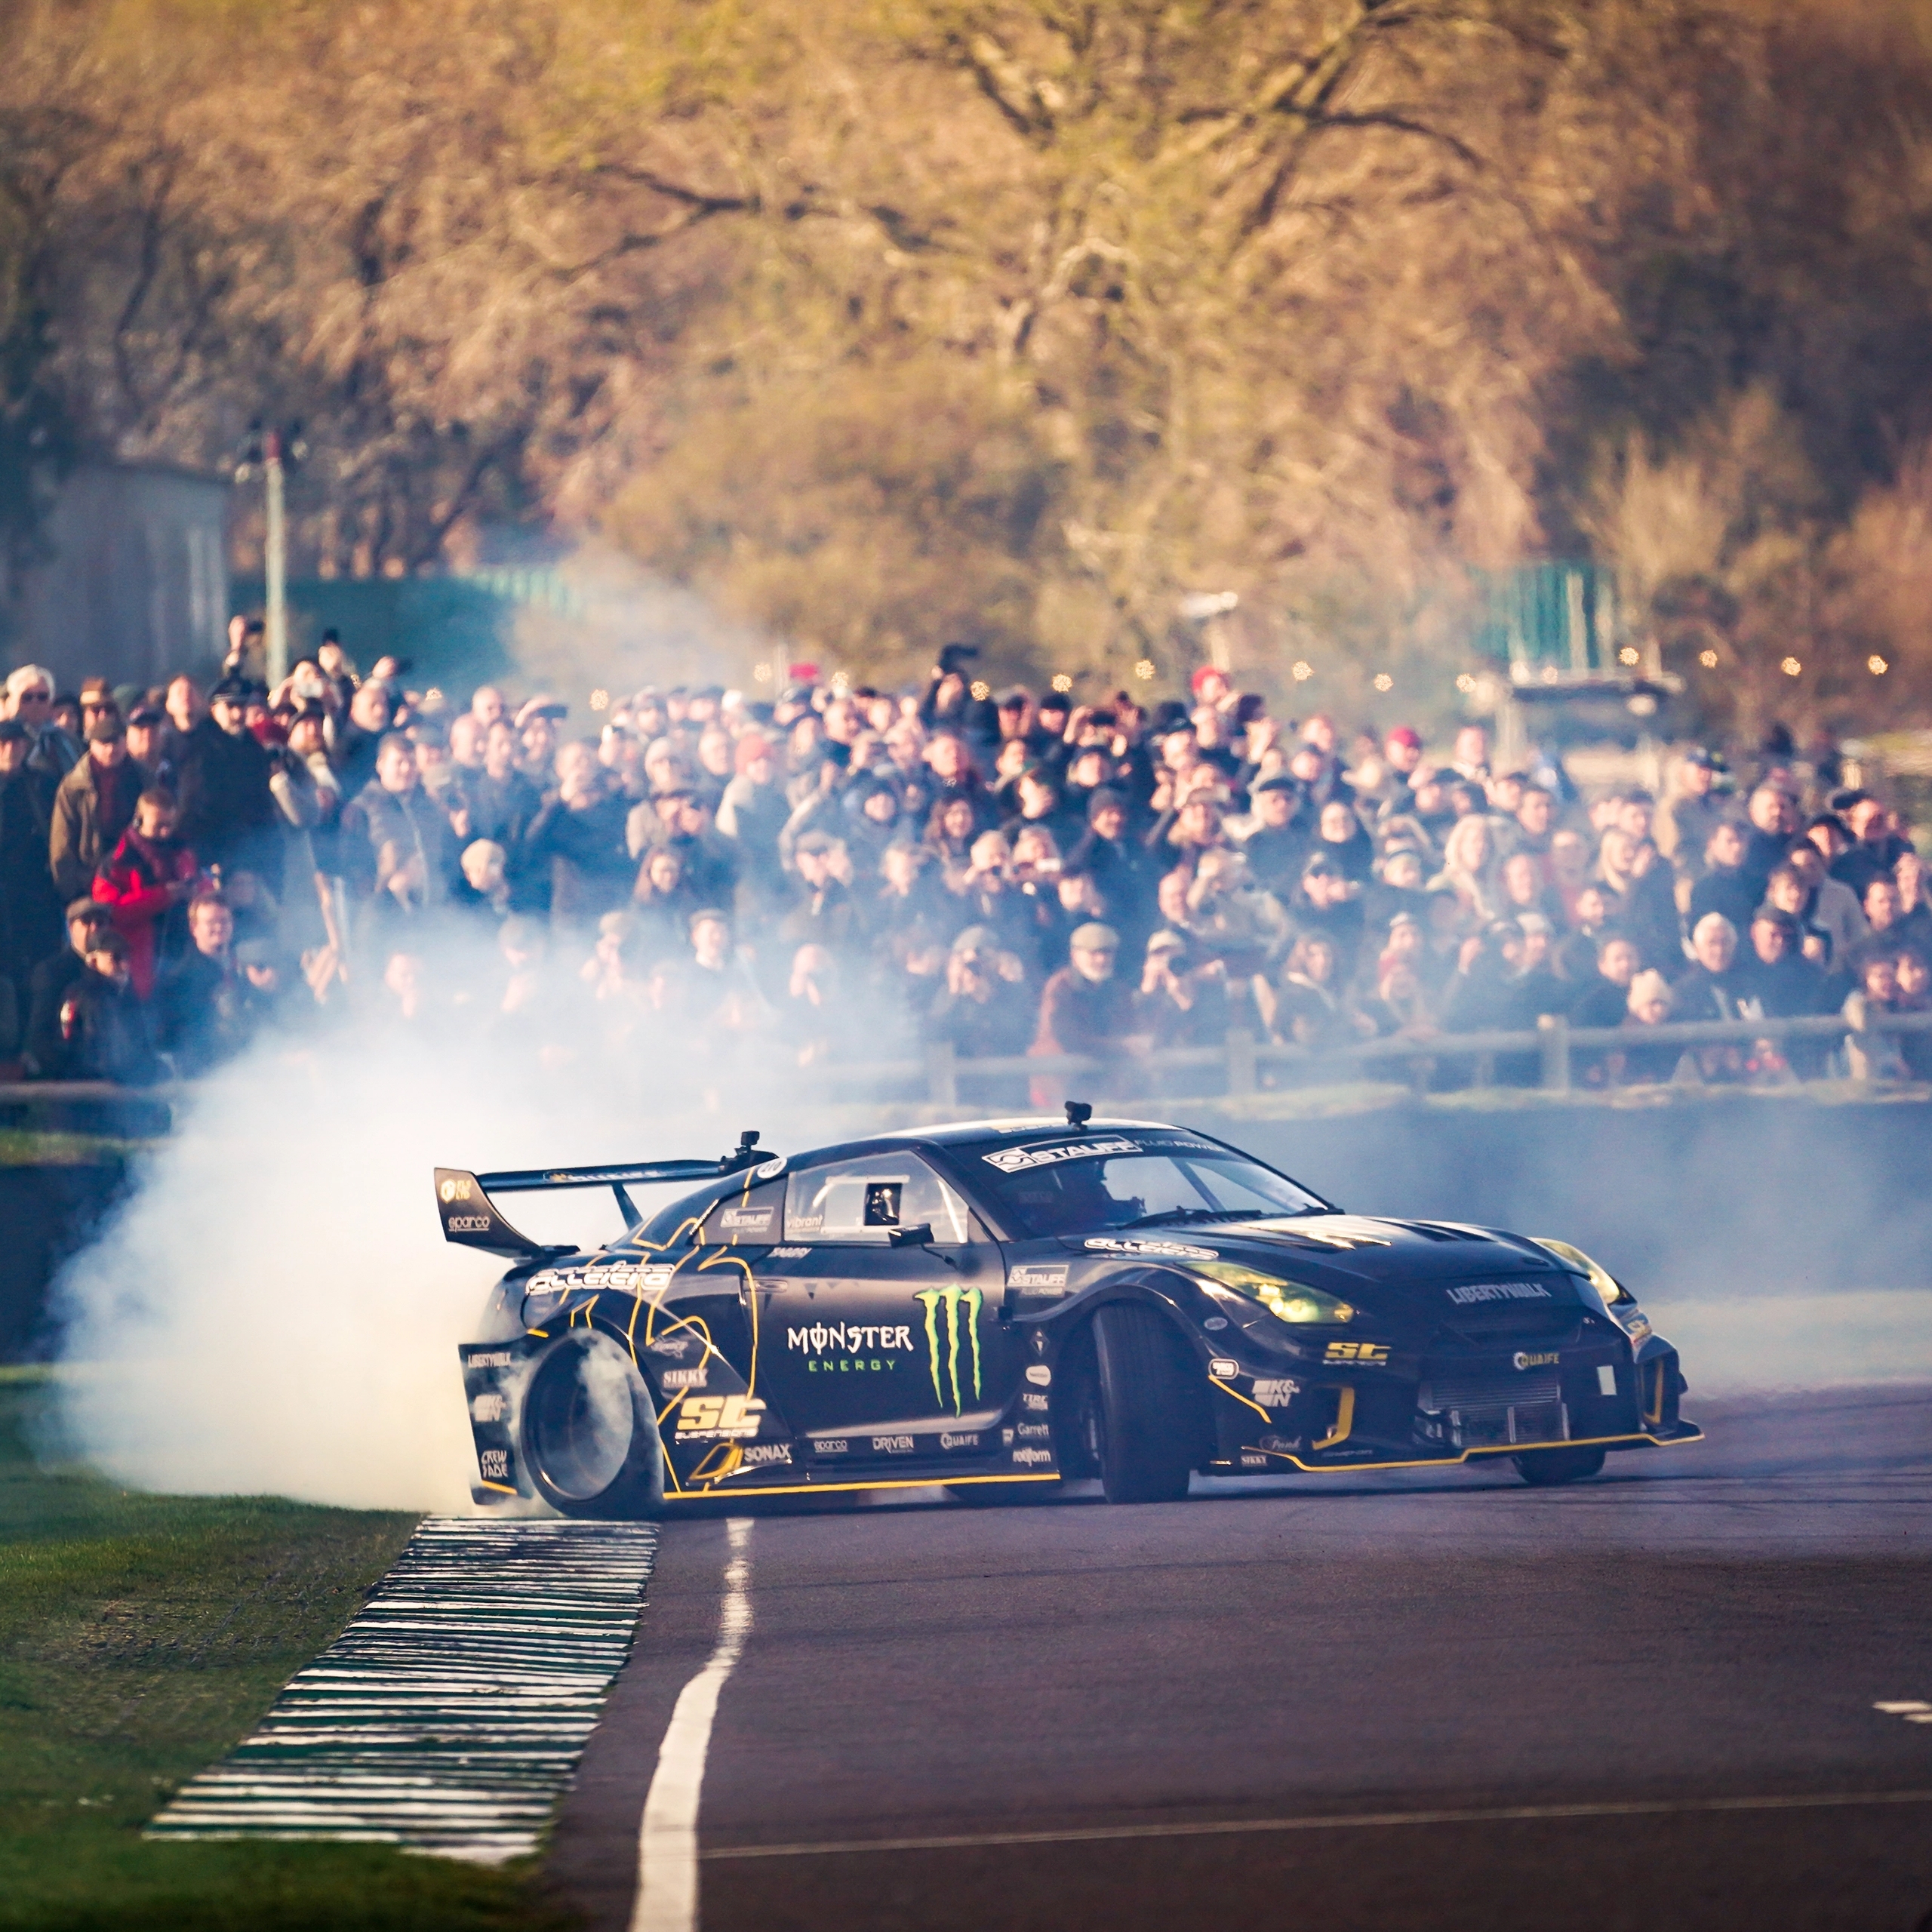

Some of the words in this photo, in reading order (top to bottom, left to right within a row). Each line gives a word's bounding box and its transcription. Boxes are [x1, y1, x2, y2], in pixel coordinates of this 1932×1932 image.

[1032, 1140, 1137, 1161] STAUFF
[787, 1214, 823, 1228] vibrant
[1022, 1274, 1066, 1284] STAUFF
[1445, 1282, 1552, 1305] LIBERTYWALK
[787, 1321, 914, 1355] MONSTER
[808, 1360, 896, 1372] ENERGY
[1513, 1352, 1560, 1370] QUAIFE
[873, 1437, 914, 1454] DRIVEN
[940, 1434, 979, 1450] QUAIFE
[744, 1444, 791, 1462] SONAX
